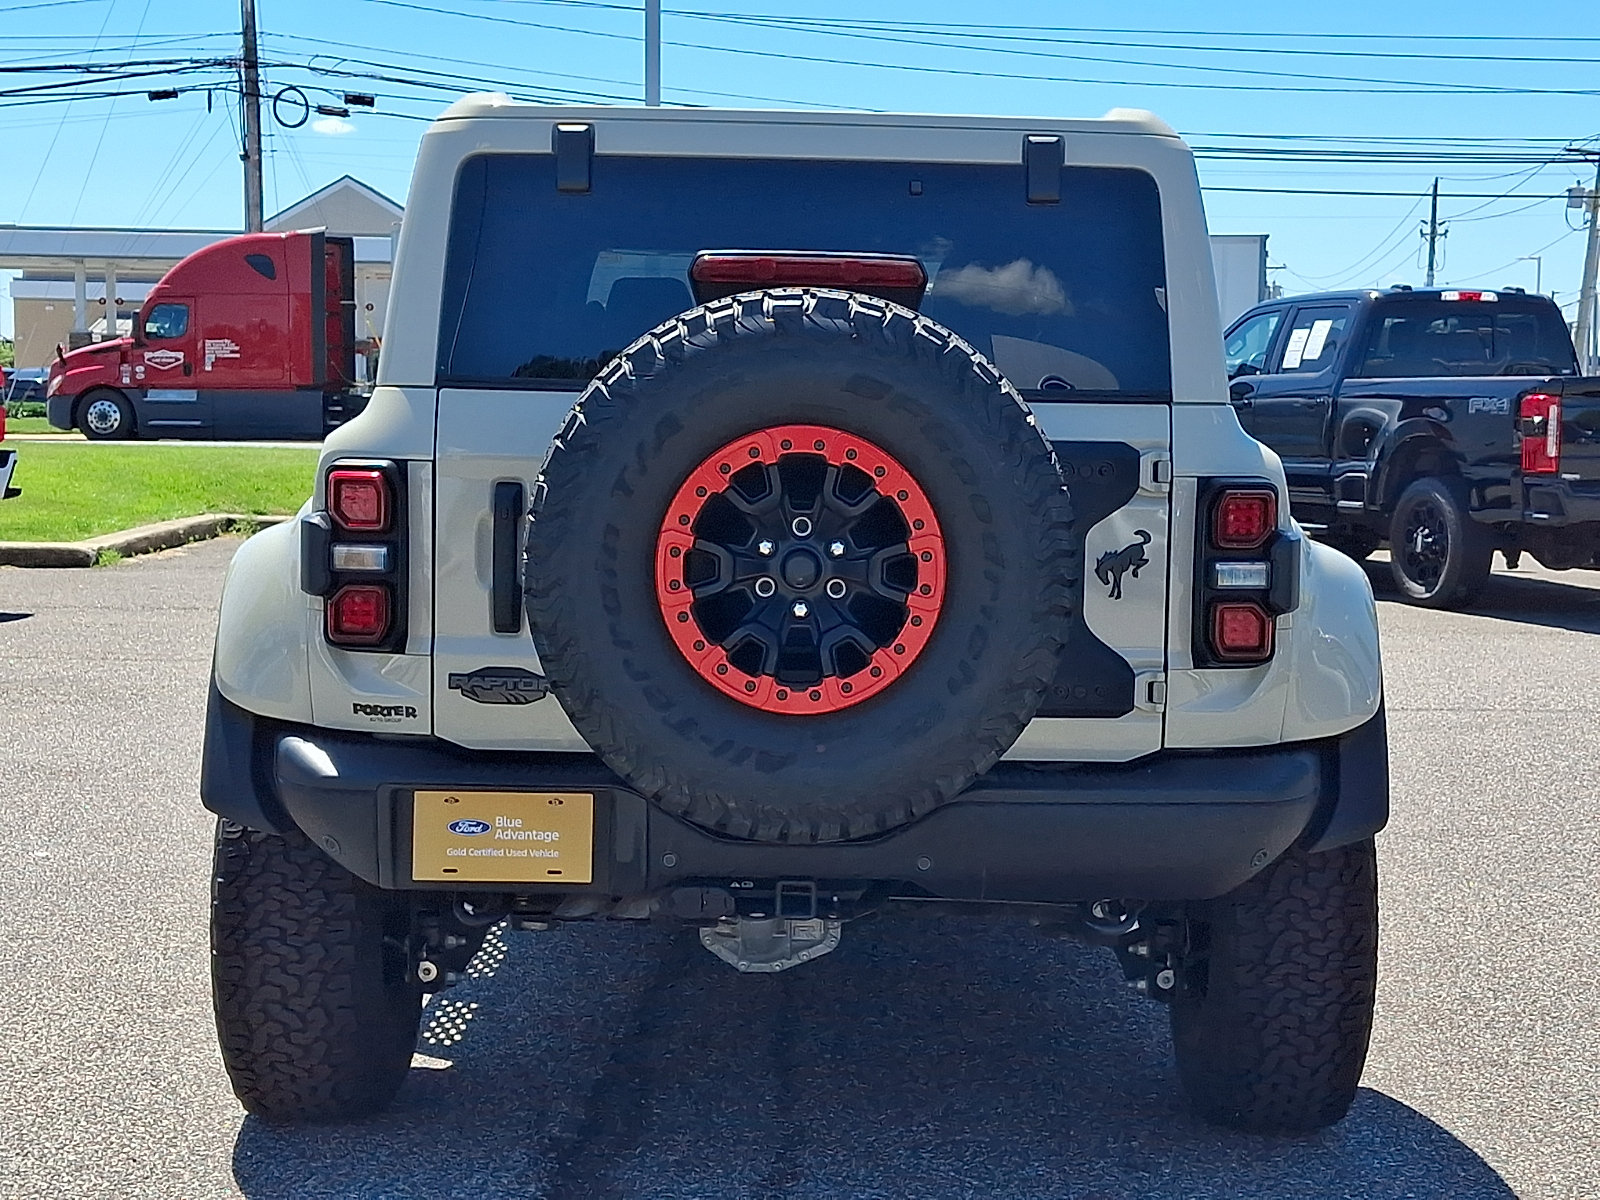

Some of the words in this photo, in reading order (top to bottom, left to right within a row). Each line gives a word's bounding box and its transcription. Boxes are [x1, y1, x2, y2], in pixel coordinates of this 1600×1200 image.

[1469, 398, 1509, 414] FX4
[352, 703, 417, 719] PORTER
[454, 820, 484, 834] Ford
[495, 816, 522, 828] Blue
[494, 829, 560, 843] Advantage
[446, 847, 466, 857] Gold
[468, 847, 504, 858] Certified
[506, 848, 528, 858] Used
[529, 849, 559, 858] Vehicle
